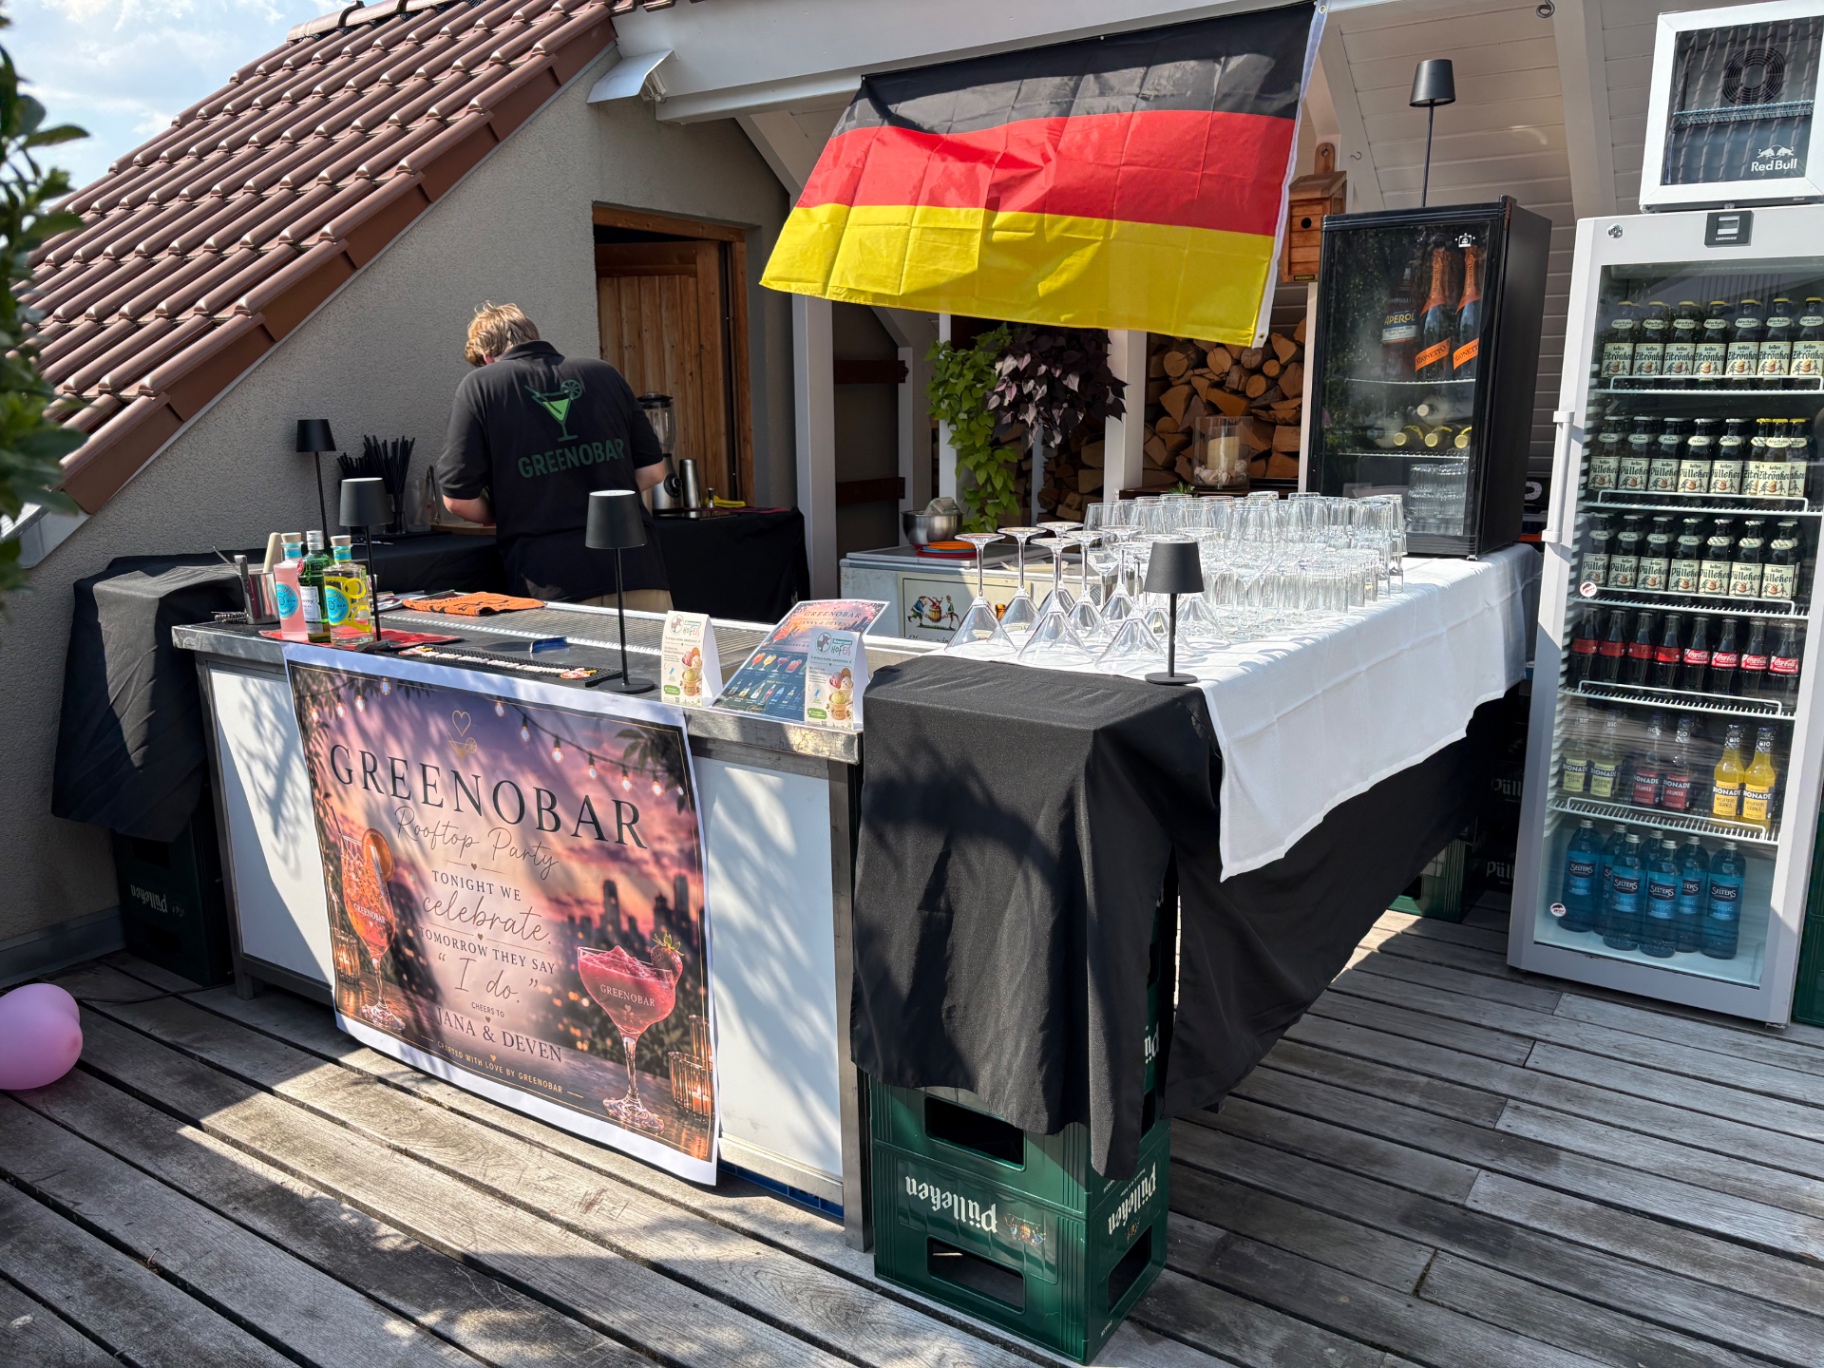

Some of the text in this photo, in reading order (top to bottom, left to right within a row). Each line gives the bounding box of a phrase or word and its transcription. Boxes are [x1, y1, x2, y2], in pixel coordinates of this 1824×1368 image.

[1751, 158, 1798, 172] Red Bull
[1384, 312, 1415, 326] APEROL
[1454, 345, 1478, 362] MIONETT
[518, 438, 624, 478] GREENOBAR
[804, 611, 862, 619] GREENOBAR
[1774, 658, 1796, 667] Coca-Cola
[330, 744, 648, 849] GREENOBAR
[394, 805, 559, 880] Rooftop Party
[1570, 863, 1593, 874] SELTERS
[432, 870, 521, 901] TONIGHT WE
[1613, 878, 1638, 890] SELTERS
[1649, 885, 1674, 897] SELTERS
[1682, 882, 1699, 892] TERS
[1711, 886, 1736, 898] SELTERS
[353, 902, 386, 924] GREENOBAR
[423, 890, 551, 945] celebrate.
[418, 926, 555, 975] TOMORROW THEY SAY
[600, 984, 656, 1007] GREENOBAR
[471, 1001, 505, 1018] CHEERS TO
[436, 1007, 562, 1063] JANA & DEVEN
[466, 1054, 483, 1067] WITH
[485, 1061, 504, 1074] LOVE
[506, 1068, 515, 1078] BY
[518, 1072, 563, 1094] GREENOBAR
[905, 1175, 998, 1234] Pülleken
[1108, 1162, 1157, 1236] Pülleken
